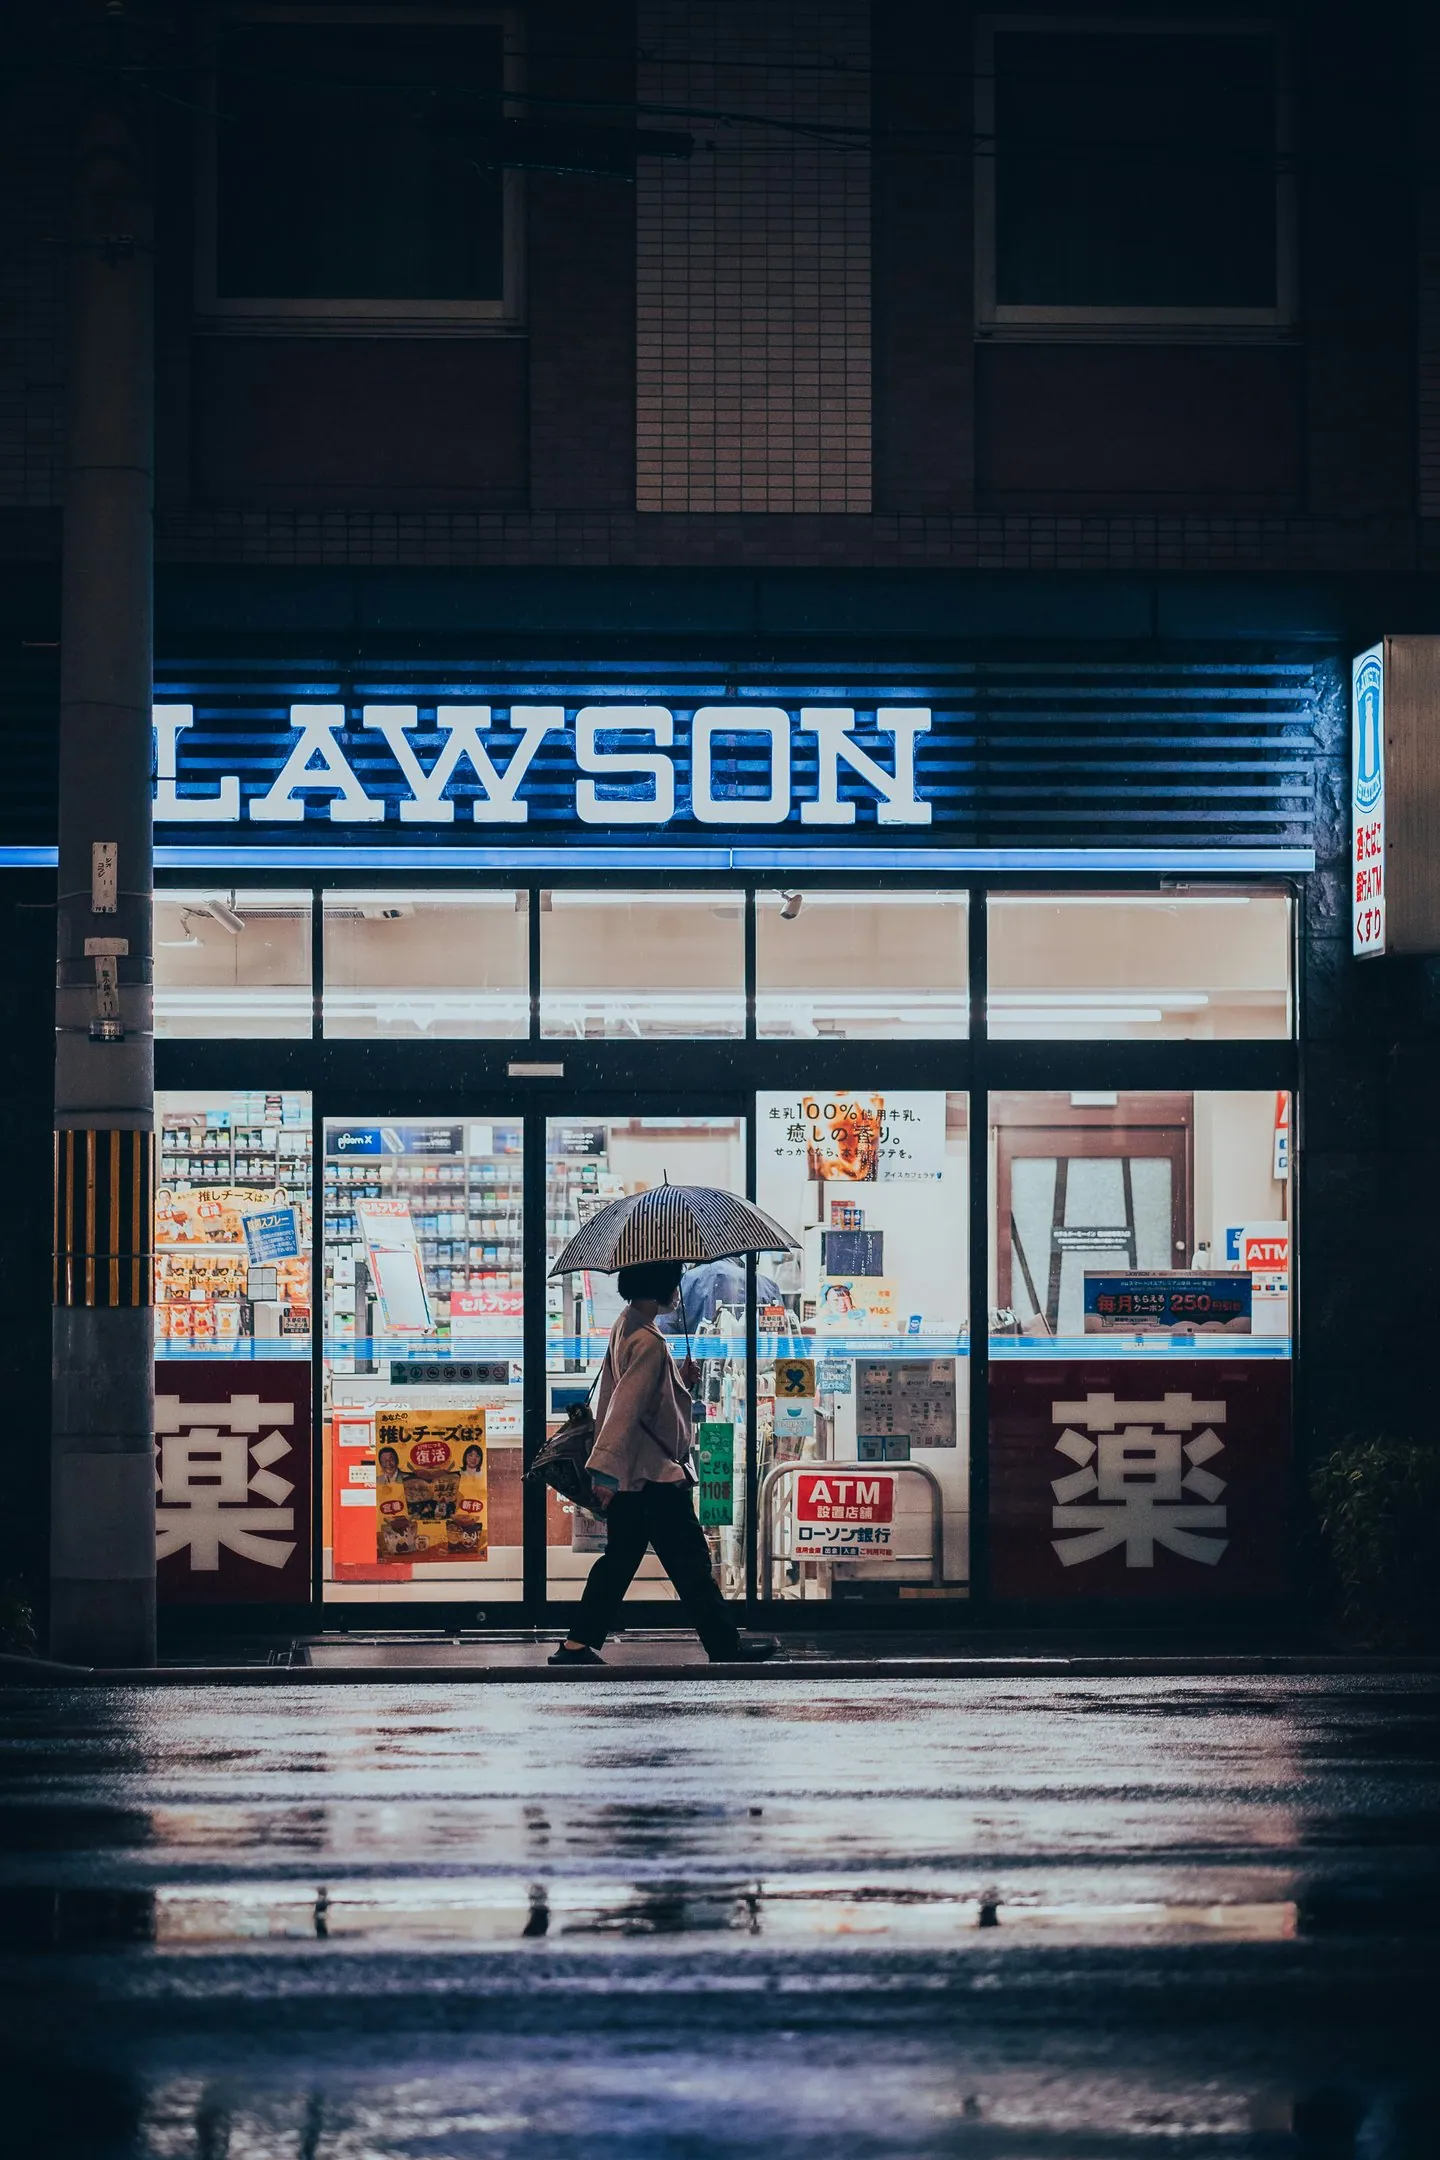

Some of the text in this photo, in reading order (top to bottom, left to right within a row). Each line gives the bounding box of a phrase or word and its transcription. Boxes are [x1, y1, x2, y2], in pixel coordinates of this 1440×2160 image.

[152, 704, 933, 825] LAWSON
[1356, 907, 1381, 943] くすり
[1247, 1244, 1288, 1260] ATM
[1097, 1294, 1133, 1313] 毎月
[1133, 1294, 1165, 1303] もらえる
[1134, 1304, 1165, 1312] クーポン
[381, 1412, 408, 1423] あなたの
[379, 1424, 483, 1443] 推しチーズは?
[416, 1448, 446, 1465] 復活
[703, 1461, 730, 1475] こども
[154, 1394, 297, 1571] 薬
[1050, 1392, 1230, 1568] 薬
[702, 1481, 731, 1499] 110番
[808, 1479, 880, 1505] ATM
[462, 1500, 482, 1511] 新作
[702, 1506, 730, 1520] のいえ
[817, 1505, 873, 1519] 設置店舗
[798, 1527, 891, 1544] ローソン銀行
[843, 1547, 857, 1555] 入金
